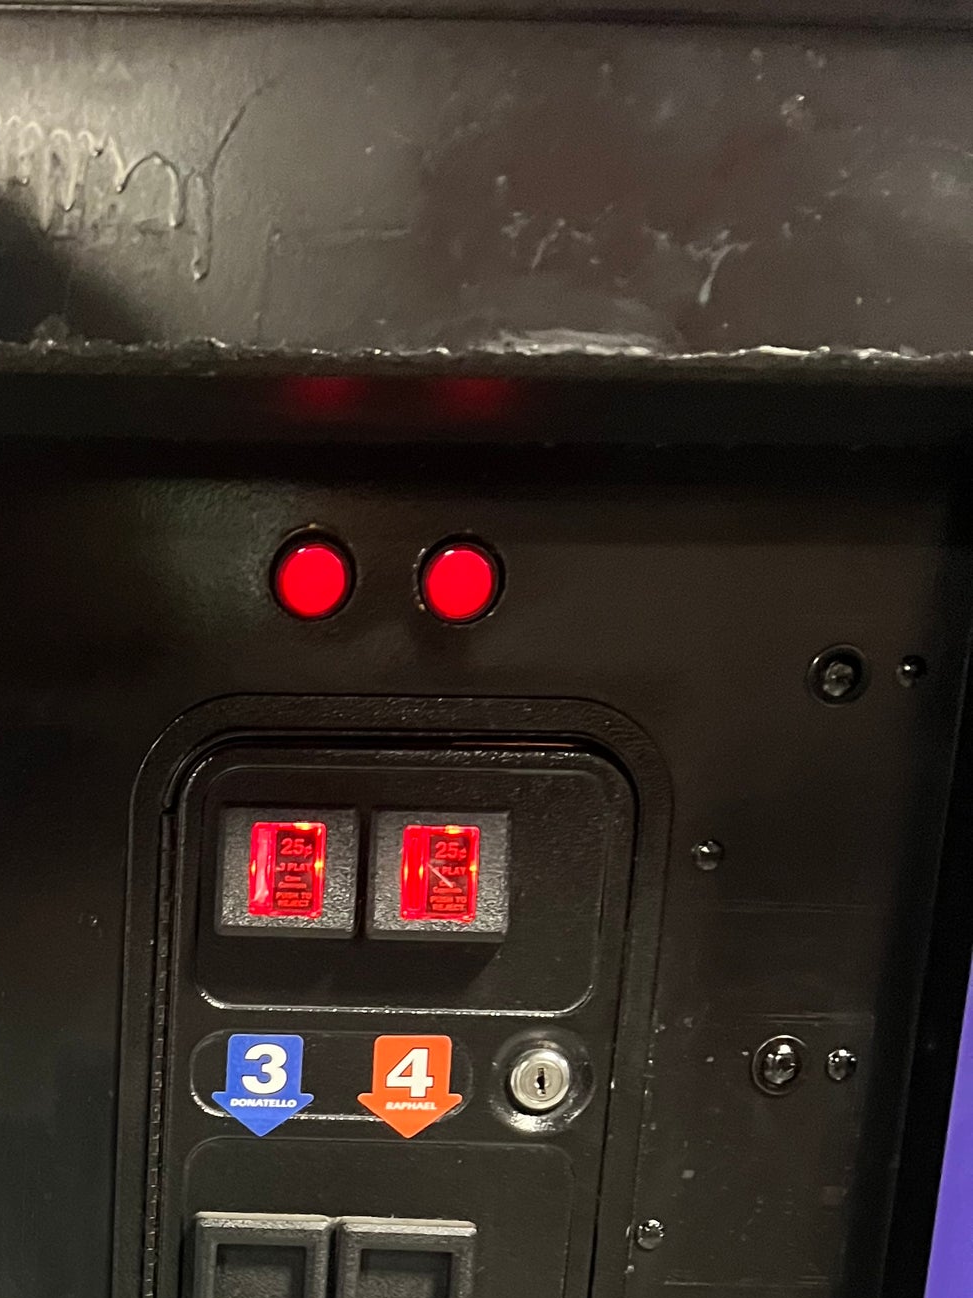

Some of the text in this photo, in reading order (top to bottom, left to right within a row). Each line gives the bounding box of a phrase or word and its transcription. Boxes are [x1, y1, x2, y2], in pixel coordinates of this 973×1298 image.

[287, 862, 312, 871] PLAY
[441, 866, 467, 875] PLAY
[455, 895, 467, 904] TO
[241, 1043, 287, 1095] 3
[385, 1047, 434, 1098] 4
[230, 1098, 298, 1108] DONATELLO
[385, 1101, 437, 1110] RAPHAEL
